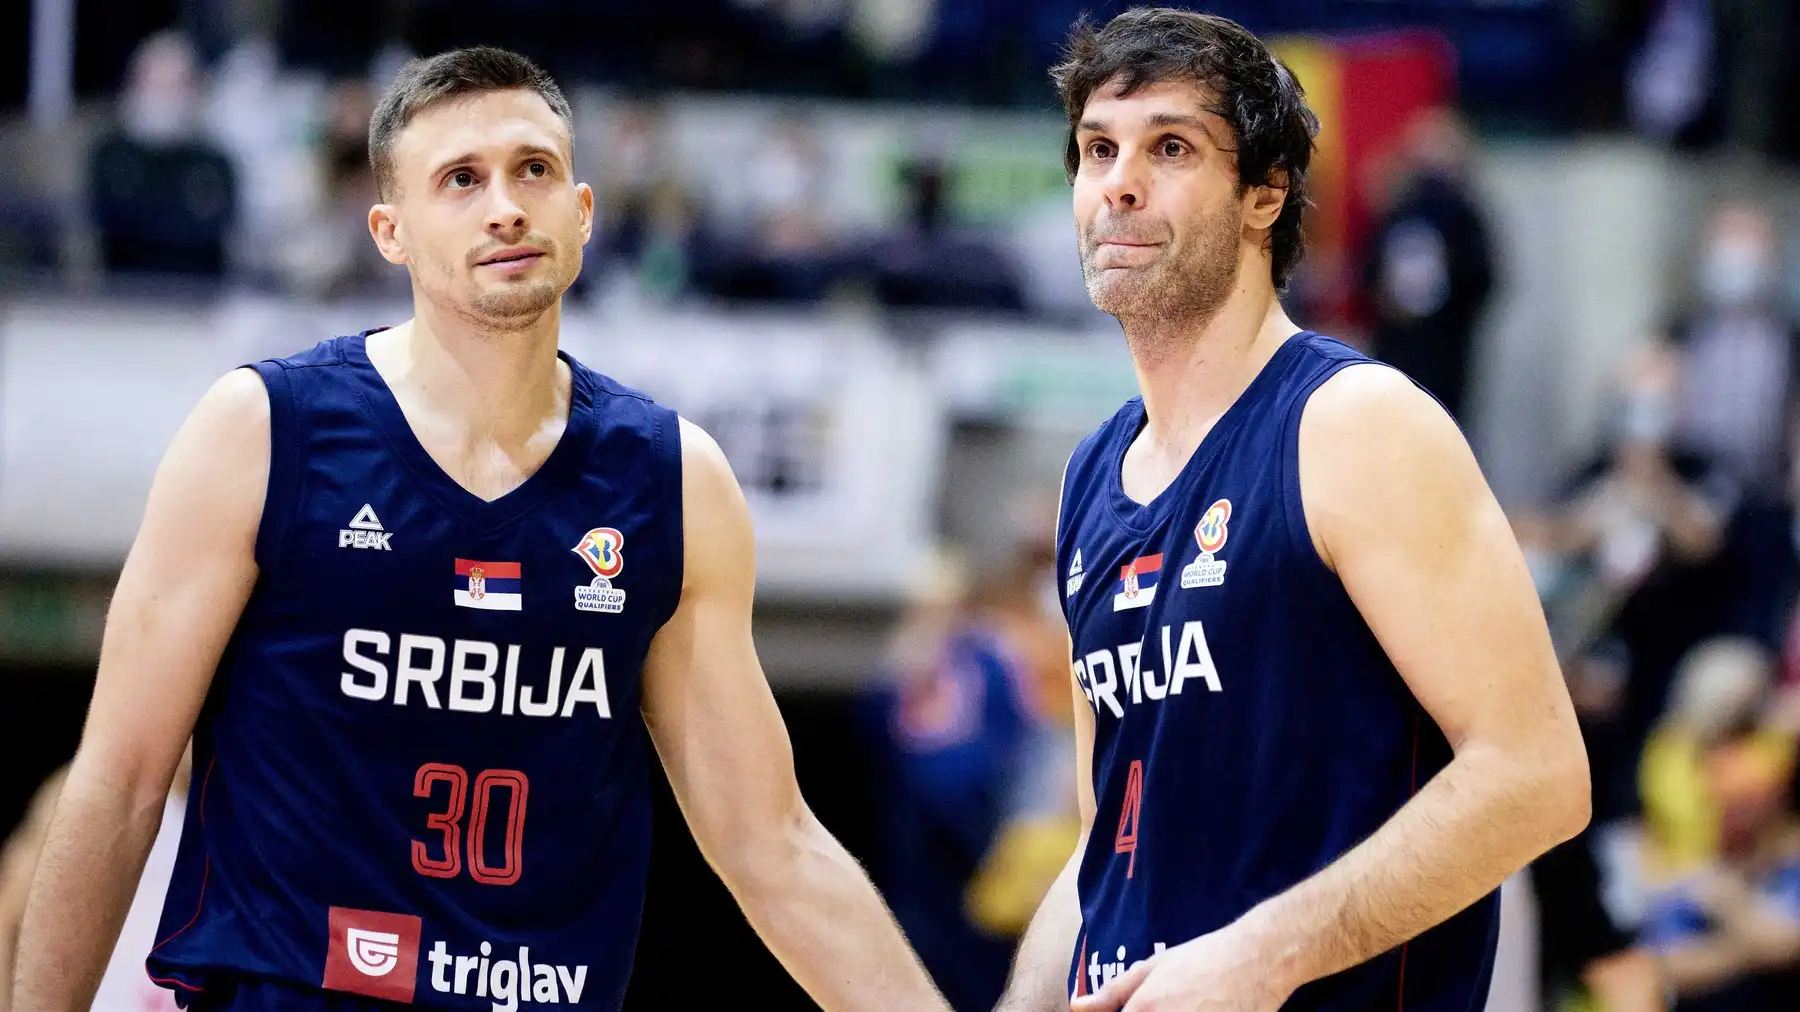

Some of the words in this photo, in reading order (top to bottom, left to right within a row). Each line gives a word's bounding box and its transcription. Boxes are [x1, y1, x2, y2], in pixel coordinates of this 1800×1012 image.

[339, 529, 394, 551] PEAK
[577, 602, 621, 611] QUALIFIERS
[578, 593, 607, 602] WORLD
[608, 595, 623, 603] CUP
[340, 628, 612, 719] SRBIJA
[411, 762, 529, 886] 30
[1115, 760, 1143, 879] 4
[428, 941, 588, 1012] triglav
